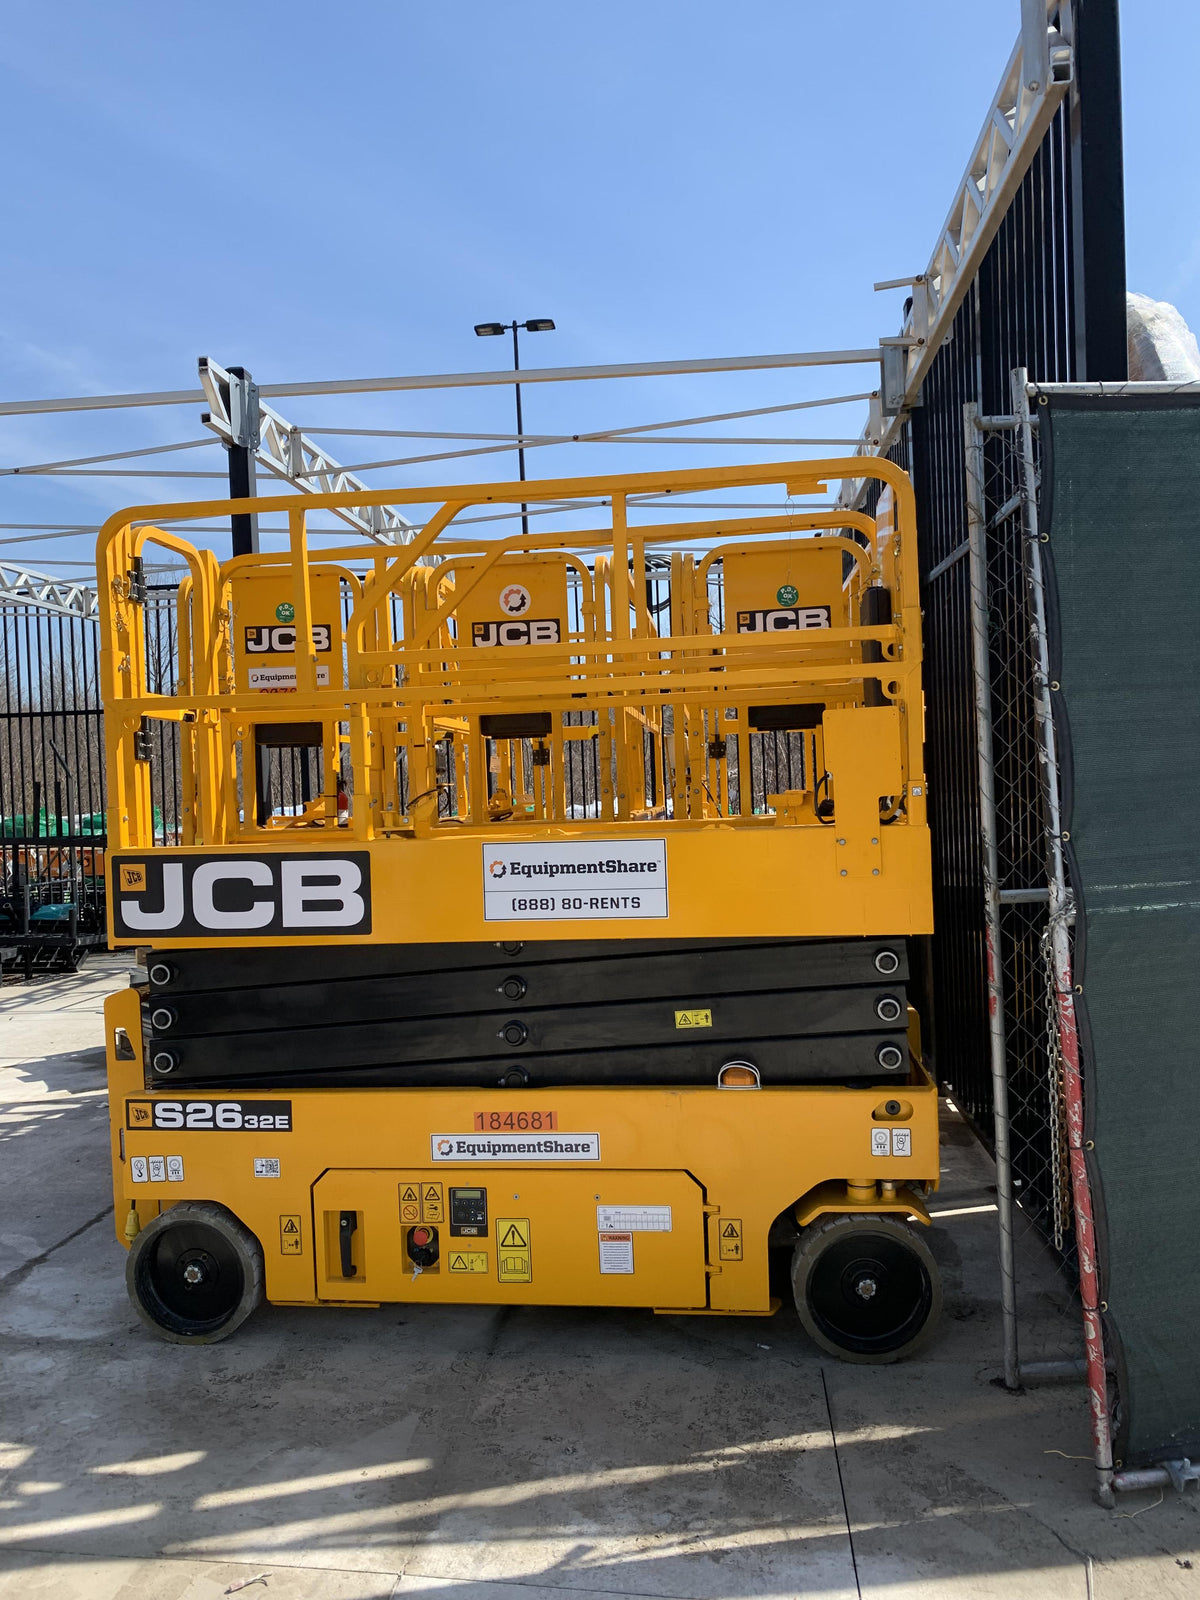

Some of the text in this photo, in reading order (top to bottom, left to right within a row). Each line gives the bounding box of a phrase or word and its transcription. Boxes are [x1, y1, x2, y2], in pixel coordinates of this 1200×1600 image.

[740, 608, 829, 633] JCB
[247, 626, 329, 651] JCB
[474, 621, 559, 647] JCB
[260, 673, 325, 682] Equipmere
[127, 869, 143, 884] JCB
[510, 860, 658, 877] EquipmentShare
[120, 859, 365, 930] JCB
[512, 897, 641, 911] (888) 80-RENTS
[477, 1112, 553, 1130] 184681
[456, 1140, 591, 1156] EquipmentShare
